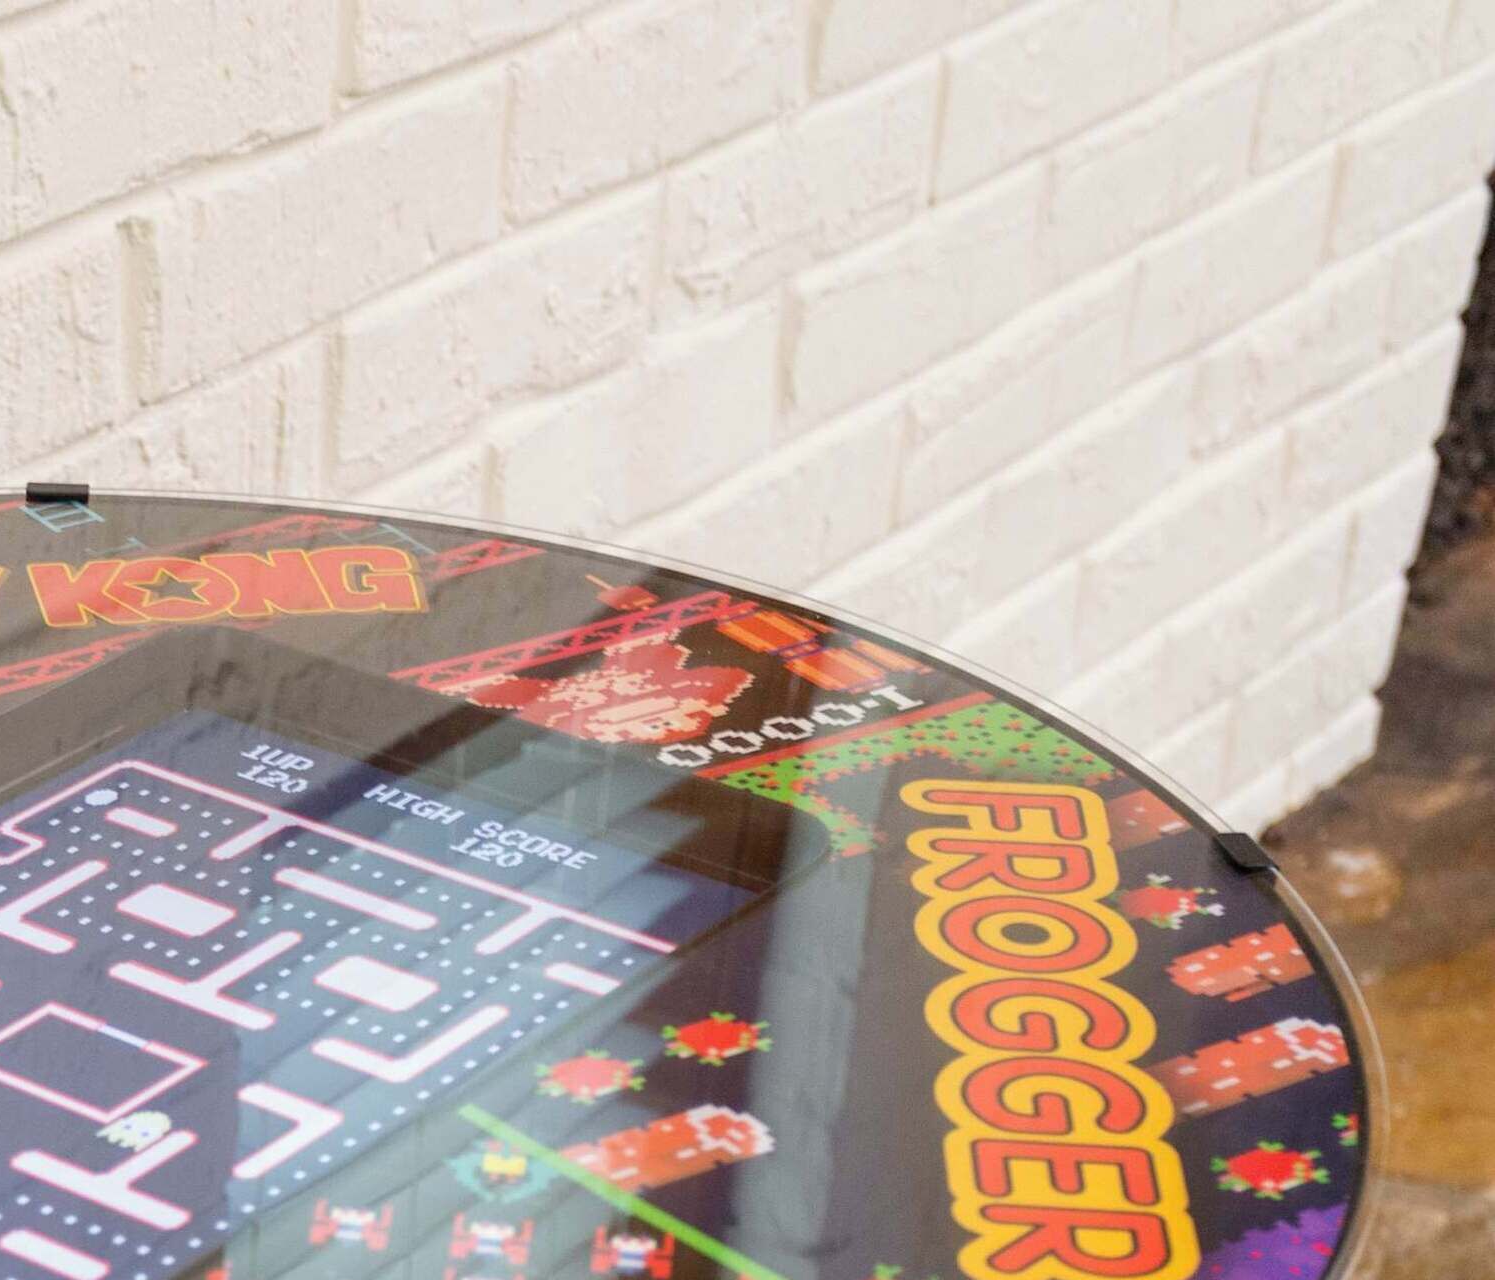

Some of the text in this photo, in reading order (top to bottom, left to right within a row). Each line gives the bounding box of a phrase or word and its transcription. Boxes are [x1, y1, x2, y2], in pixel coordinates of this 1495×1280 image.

[26, 546, 428, 629] KONG
[241, 744, 316, 772] 1UP
[236, 765, 310, 795] 120
[363, 784, 598, 871] HIGH SCORE
[450, 838, 525, 869] 120
